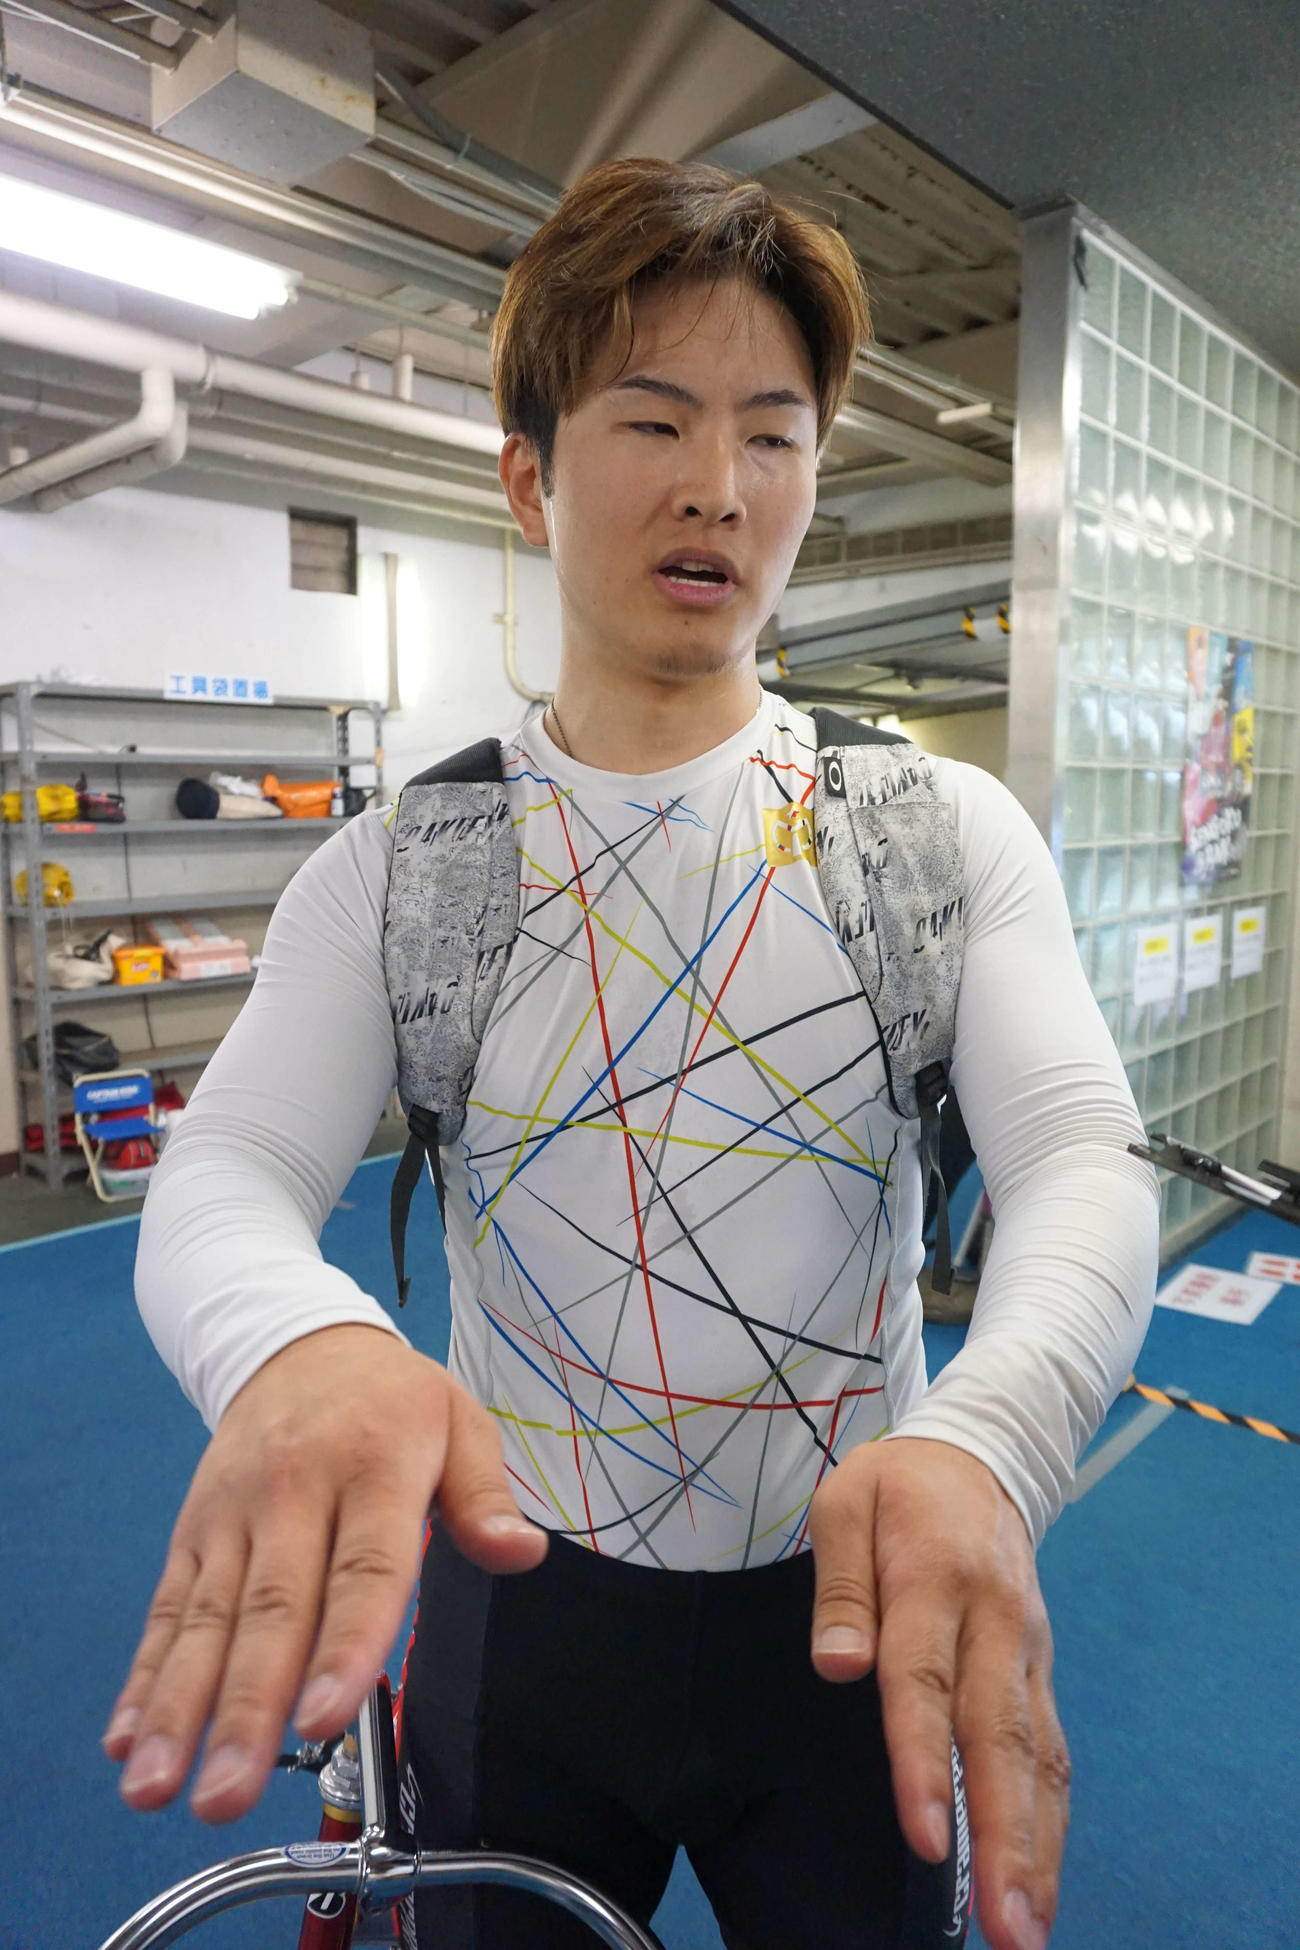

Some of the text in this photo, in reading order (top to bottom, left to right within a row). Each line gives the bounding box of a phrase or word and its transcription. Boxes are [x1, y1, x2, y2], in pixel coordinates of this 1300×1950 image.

[169, 675, 269, 699] 工具袋置場
